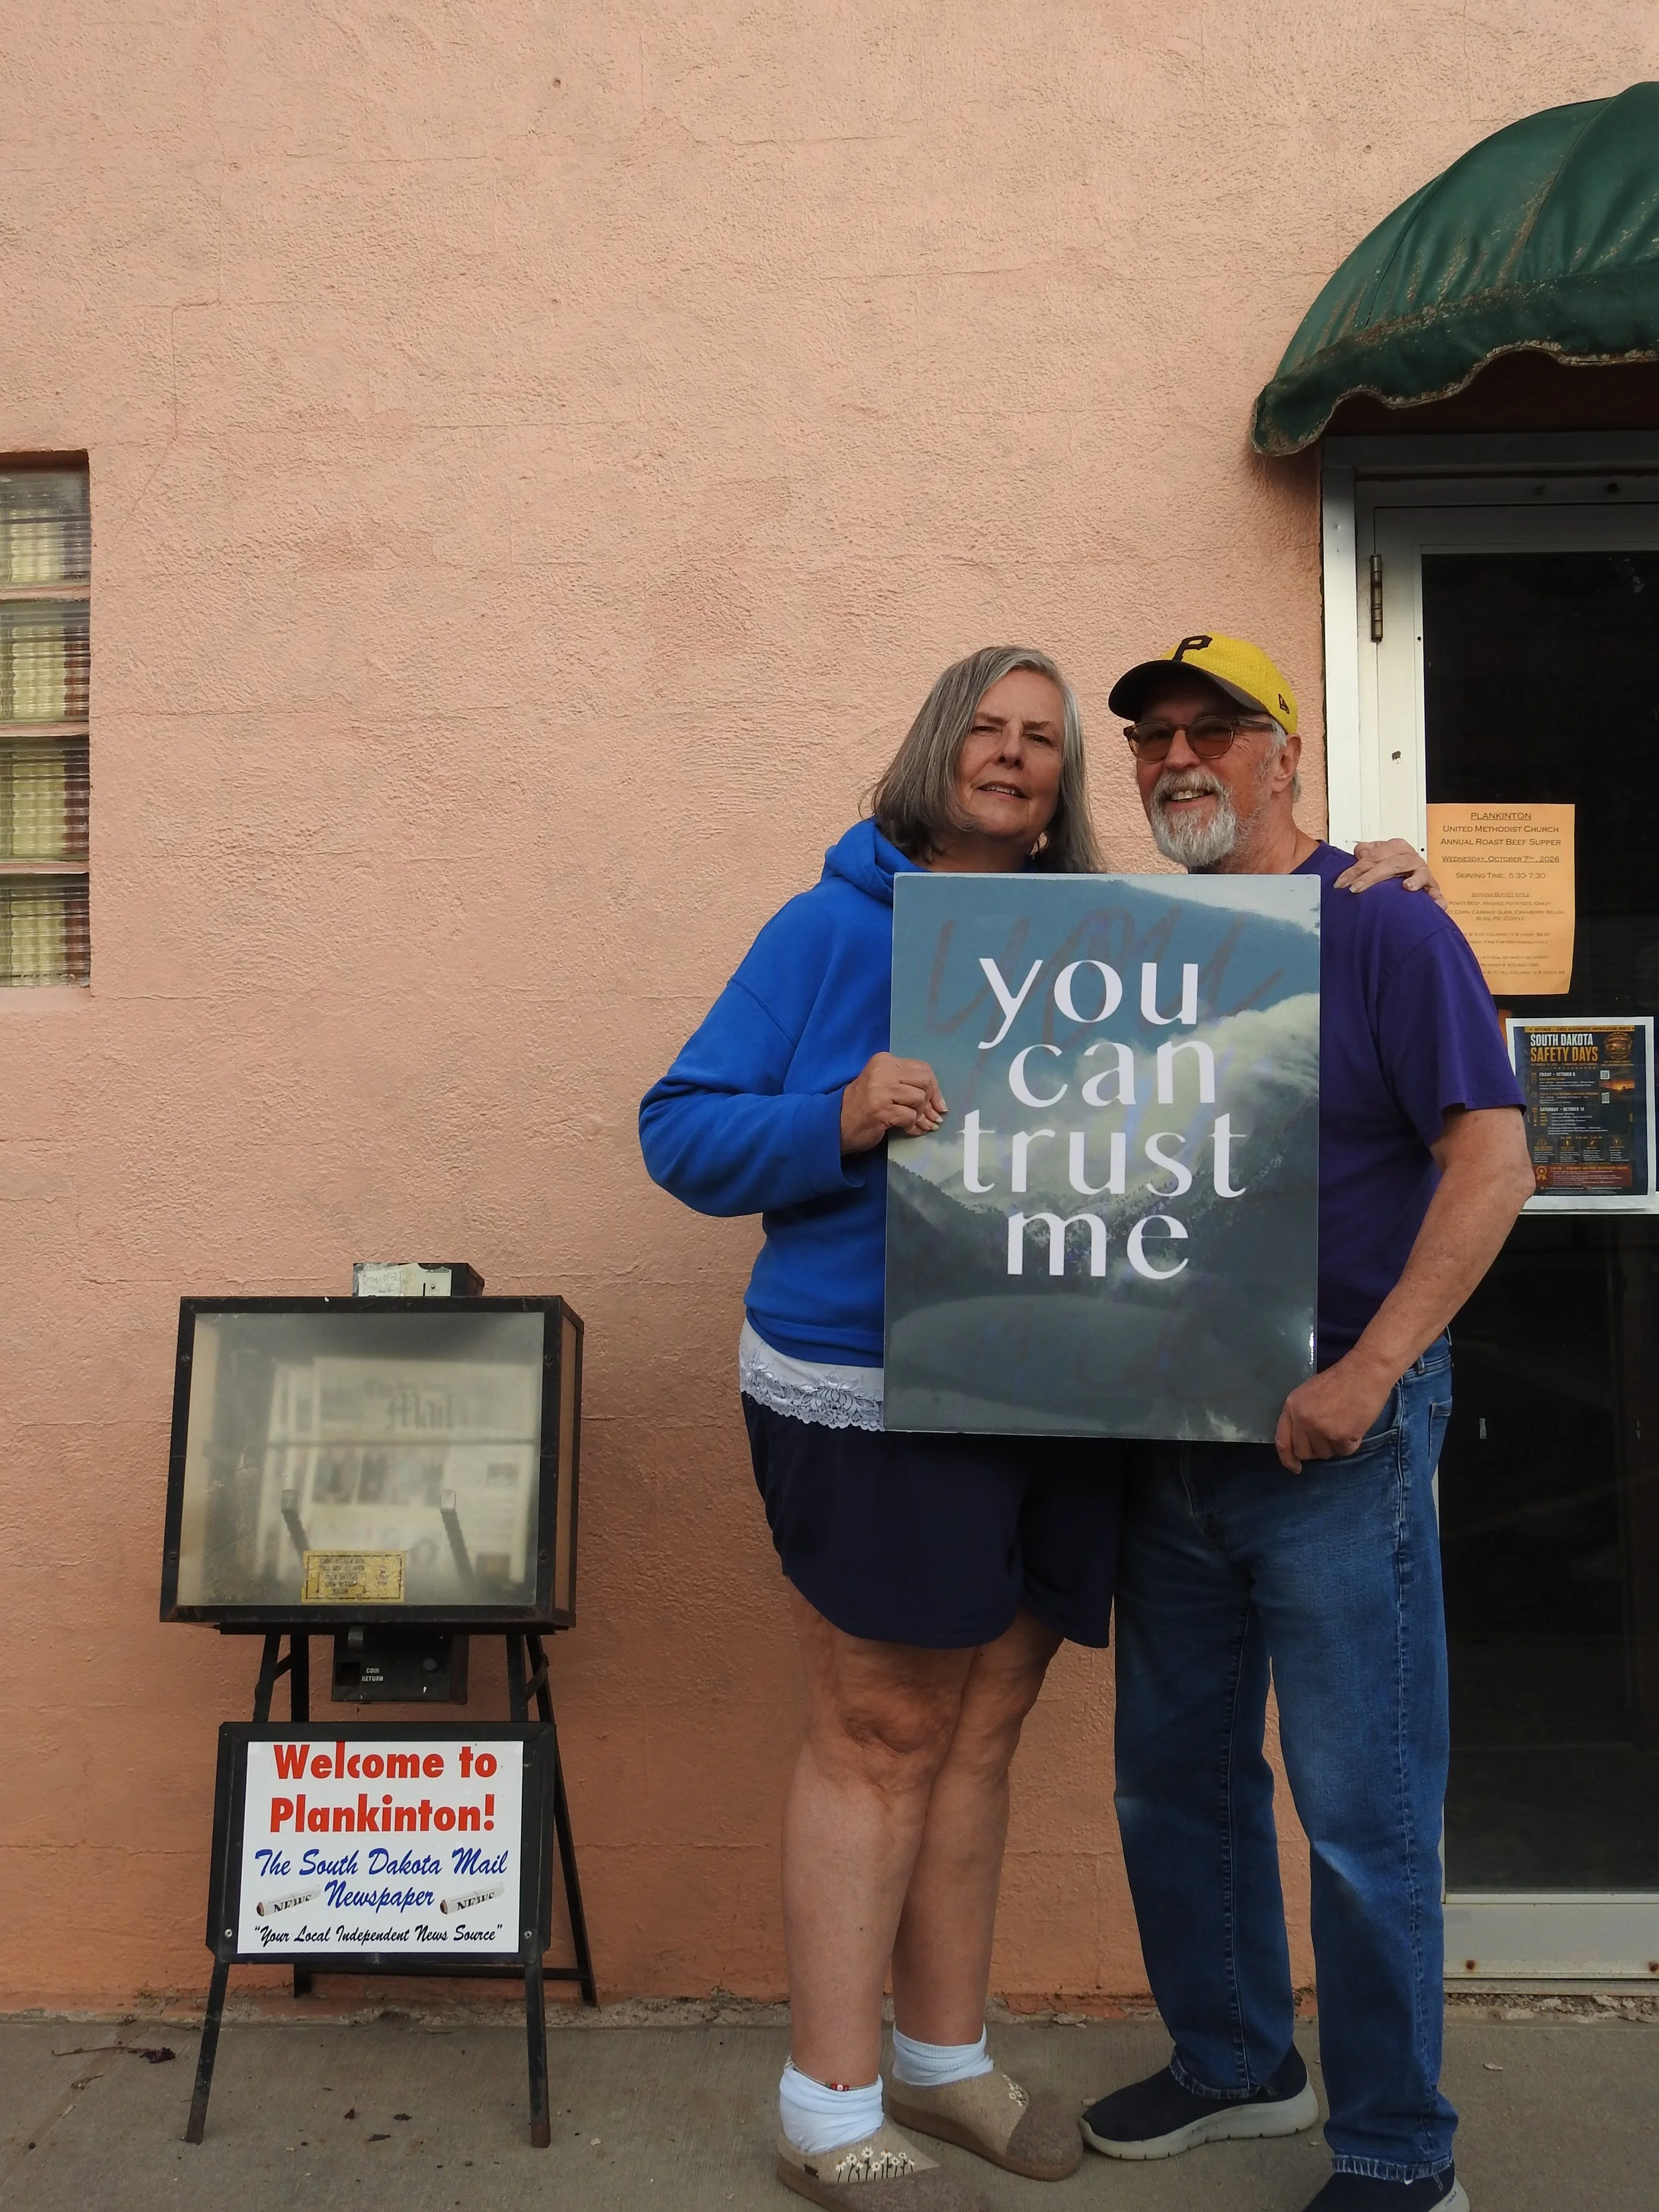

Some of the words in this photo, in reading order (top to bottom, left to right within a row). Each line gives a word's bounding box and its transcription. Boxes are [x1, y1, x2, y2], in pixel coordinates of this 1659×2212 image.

[1172, 635, 1213, 662] P
[977, 958, 1199, 1049] you
[1530, 1033, 1558, 1047] SOUTH
[1561, 1033, 1593, 1046] DAKOTA
[1530, 1047, 1569, 1063] SAFETY
[1572, 1046, 1598, 1062] DAYS
[1008, 1039, 1216, 1108] can
[956, 1110, 1248, 1199] trust
[1007, 1213, 1190, 1281] me
[273, 1741, 444, 1780] Welcome
[459, 1745, 497, 1779] to
[269, 1794, 496, 1833] Plankinton!
[254, 1849, 291, 1877] The
[299, 1849, 360, 1876] South
[368, 1848, 443, 1876] Dakota
[451, 1848, 509, 1875] Mail
[273, 1893, 312, 1913] NEWS
[324, 1880, 435, 1914] Newspaper
[456, 1891, 496, 1911] NEWS
[293, 1925, 331, 1943] Local
[336, 1925, 410, 1946] Independent
[415, 1925, 448, 1942] News
